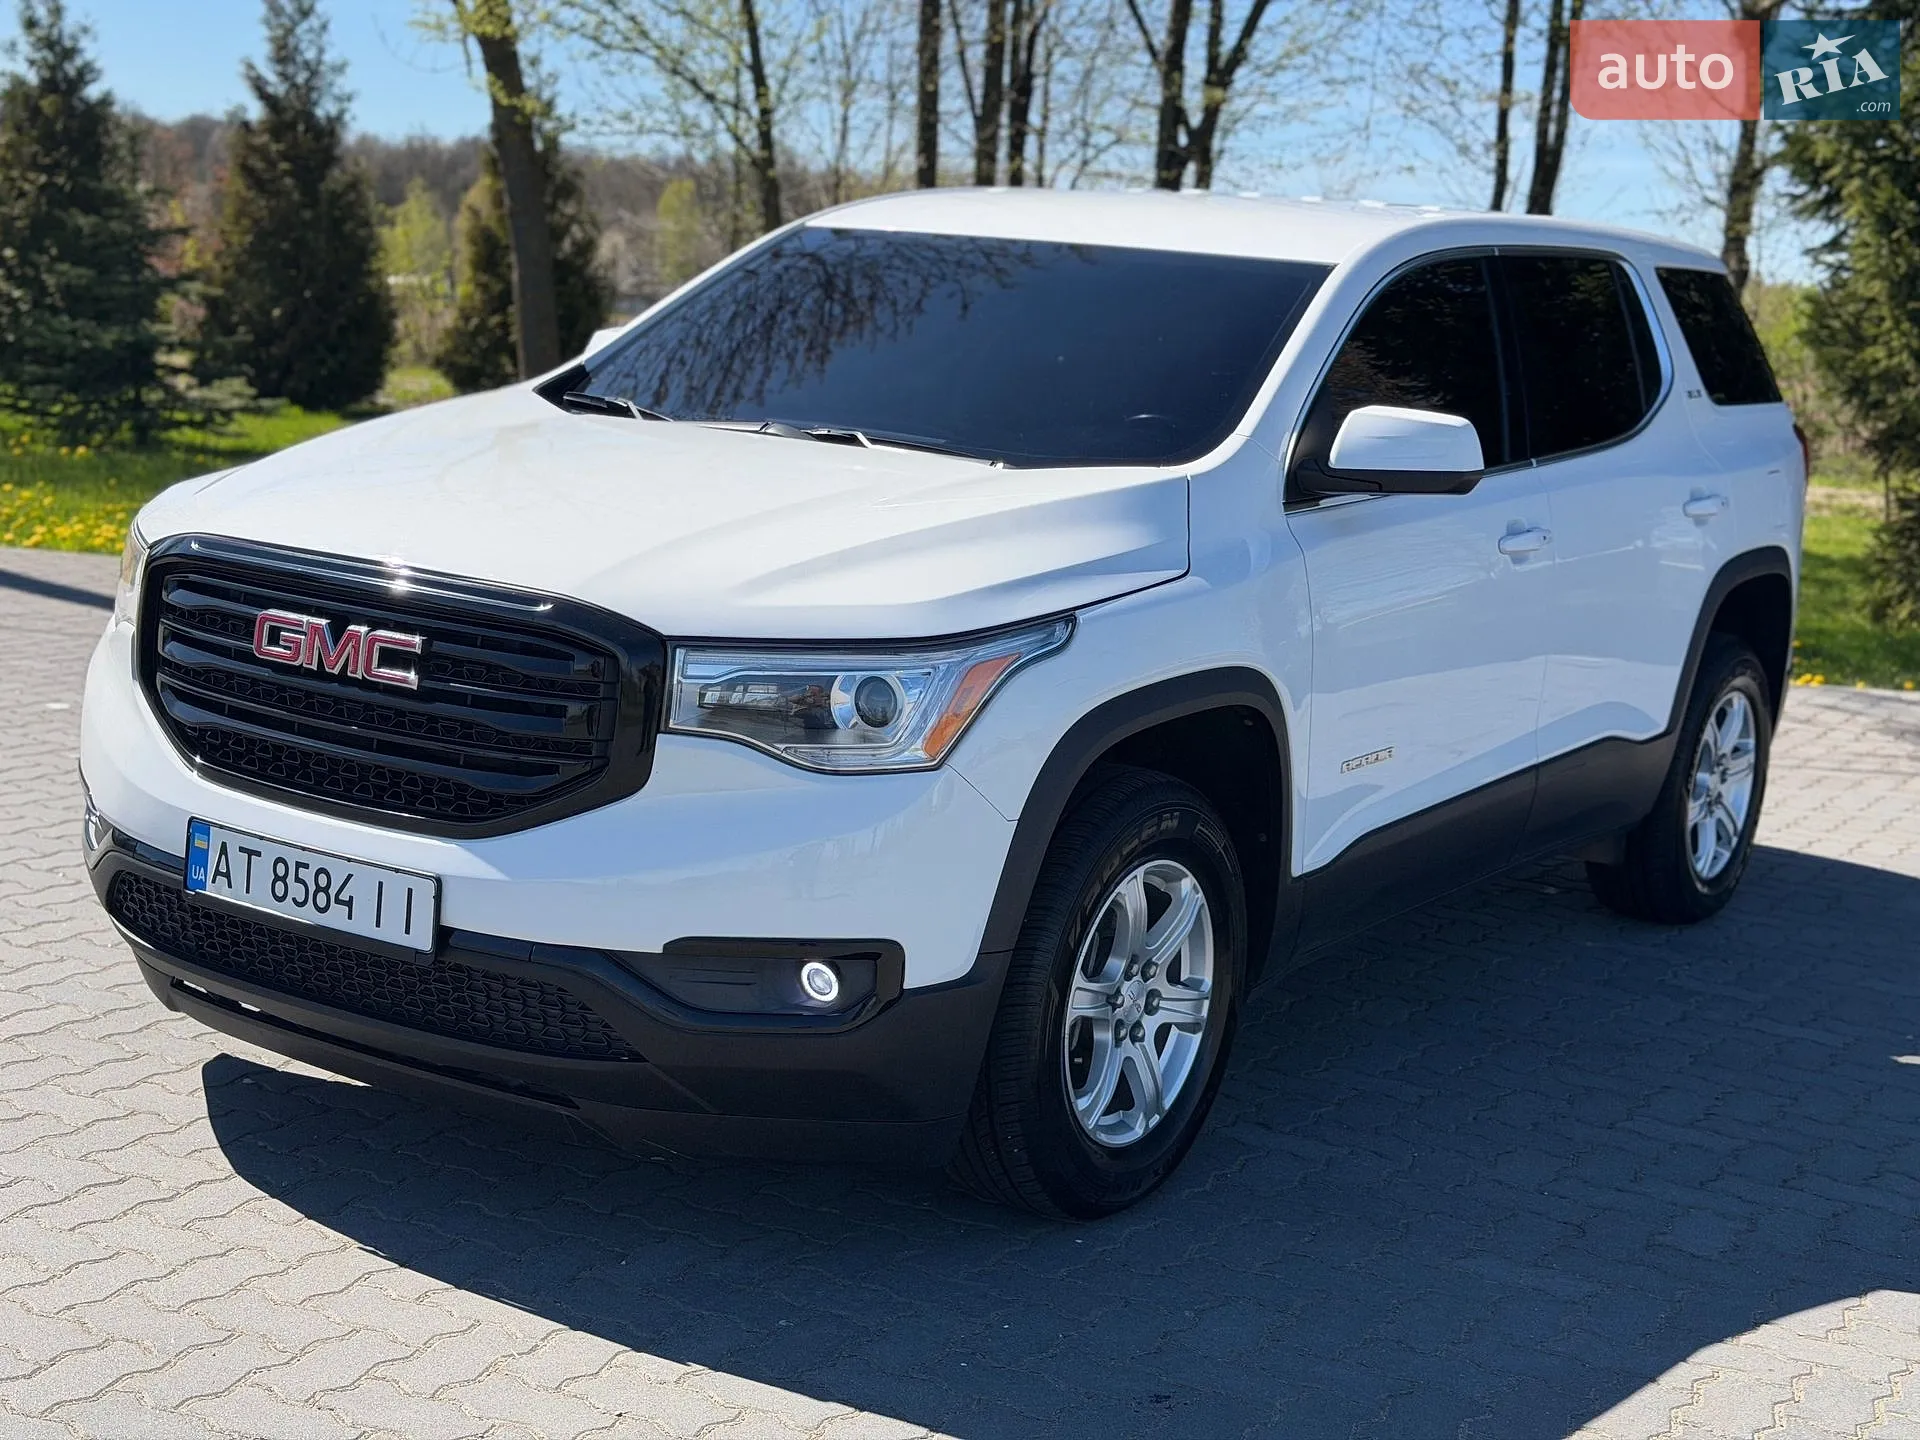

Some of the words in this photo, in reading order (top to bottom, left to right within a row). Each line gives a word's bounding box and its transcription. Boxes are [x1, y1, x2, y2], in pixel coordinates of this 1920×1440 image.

[253, 608, 425, 690] GMC
[192, 865, 205, 882] UA
[211, 841, 262, 894] AT
[271, 856, 354, 920] 8584
